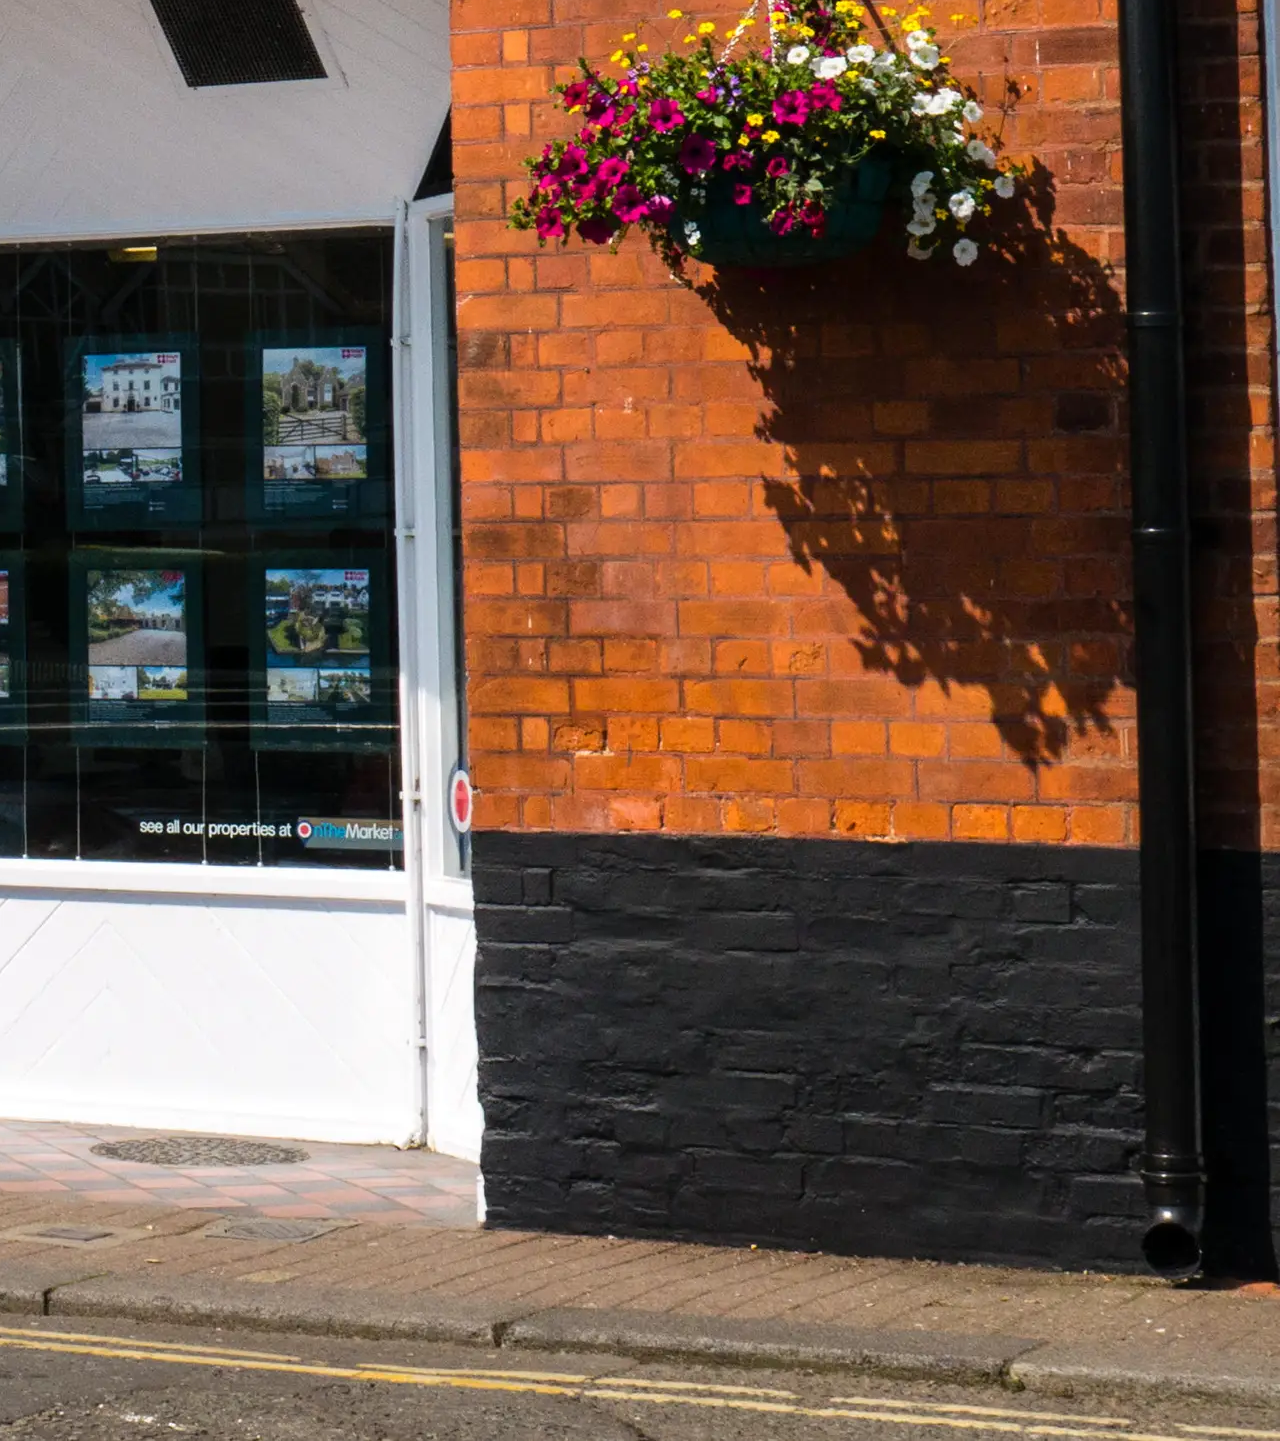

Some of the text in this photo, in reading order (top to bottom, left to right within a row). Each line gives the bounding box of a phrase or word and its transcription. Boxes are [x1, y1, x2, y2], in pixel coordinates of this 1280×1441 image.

[139, 820, 163, 834] see
[166, 819, 180, 835] all
[183, 823, 204, 836] our
[208, 821, 276, 839] properties
[278, 823, 292, 837] at
